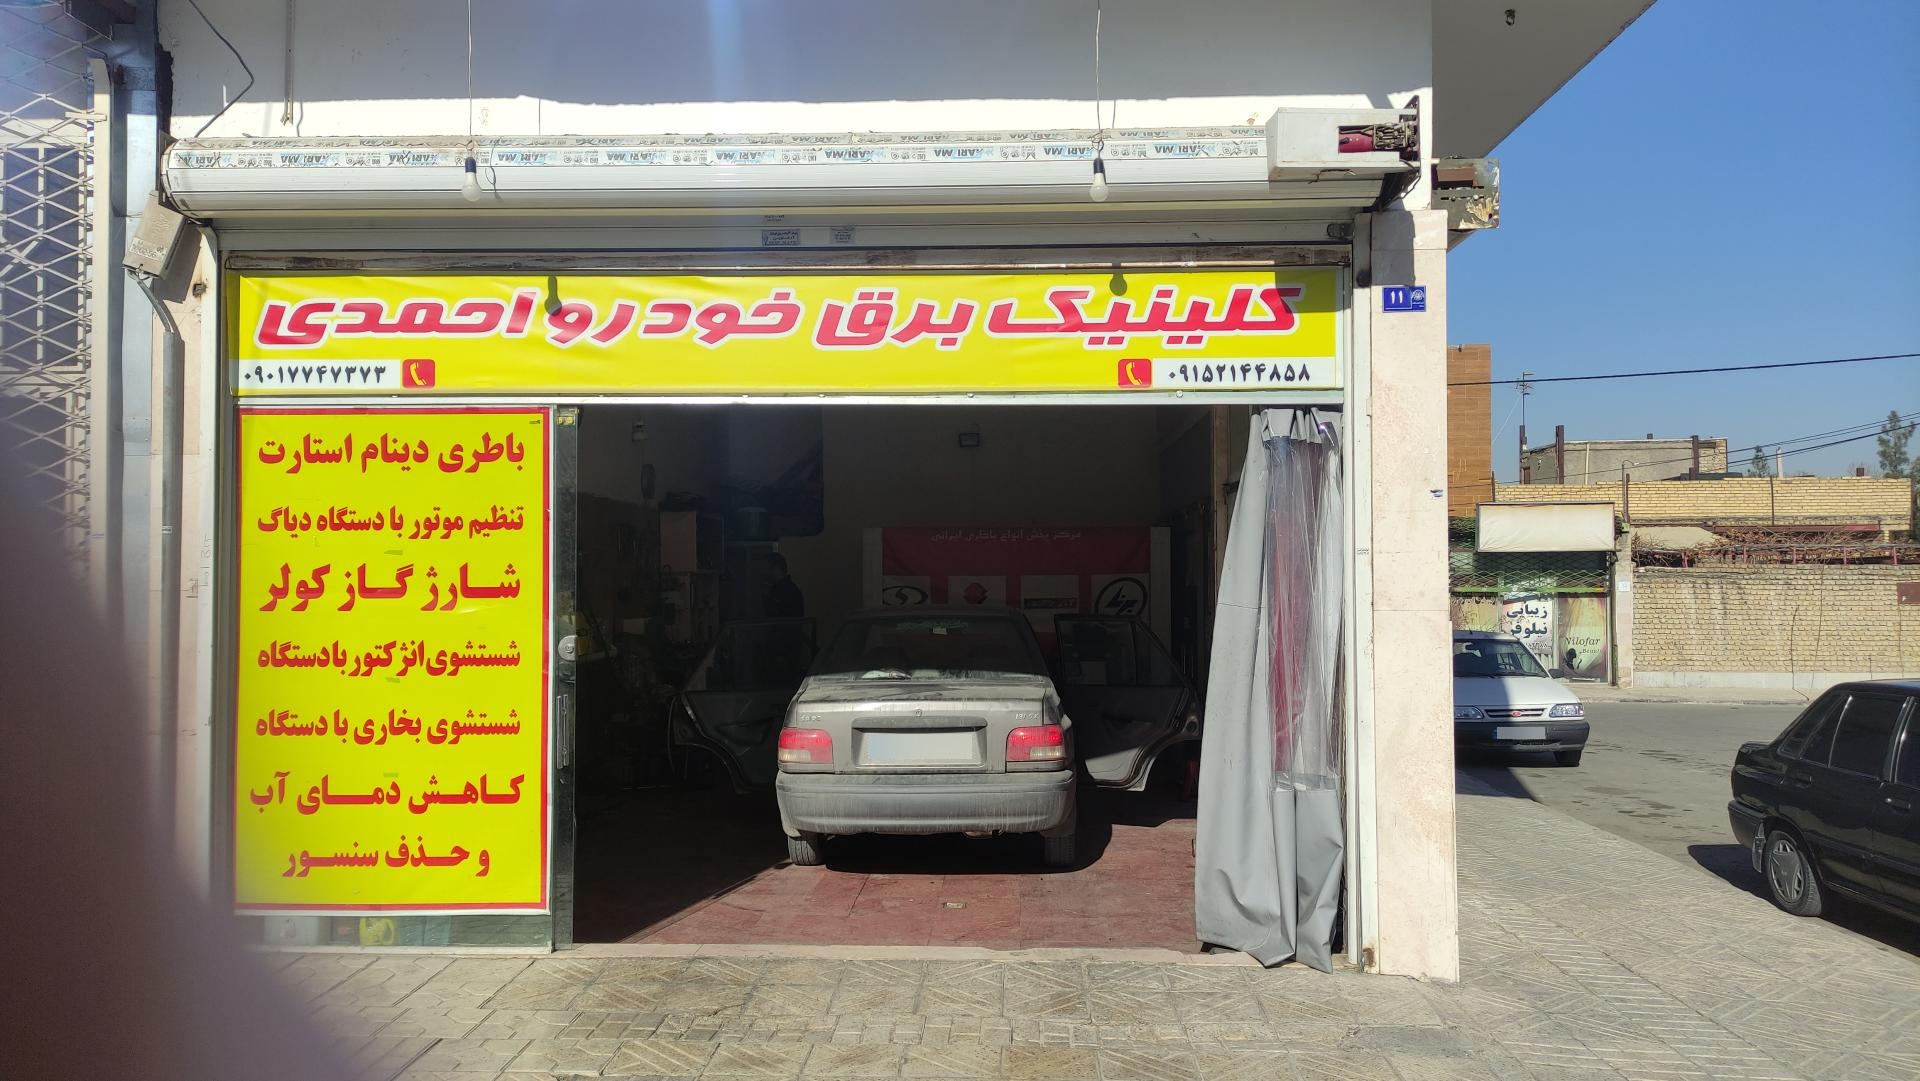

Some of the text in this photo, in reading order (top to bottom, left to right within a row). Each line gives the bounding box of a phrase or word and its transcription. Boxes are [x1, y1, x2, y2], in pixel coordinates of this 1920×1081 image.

[258, 286, 1301, 348] کلینیک برق خودرو احمدی
[259, 433, 524, 474] باطری دینام استارت
[258, 506, 524, 539] تنظیم موتور با دستگاه دیاگ
[261, 564, 520, 611] شارژ گاز کولر
[1507, 601, 1547, 618] زیبایی
[258, 641, 520, 677] شستشوی انژکتور با دستگاه
[257, 710, 520, 745] شستشوی بخاری با دستگاه
[249, 771, 525, 815] کاهش دمای آب
[283, 836, 490, 878] و حذف سنسور
